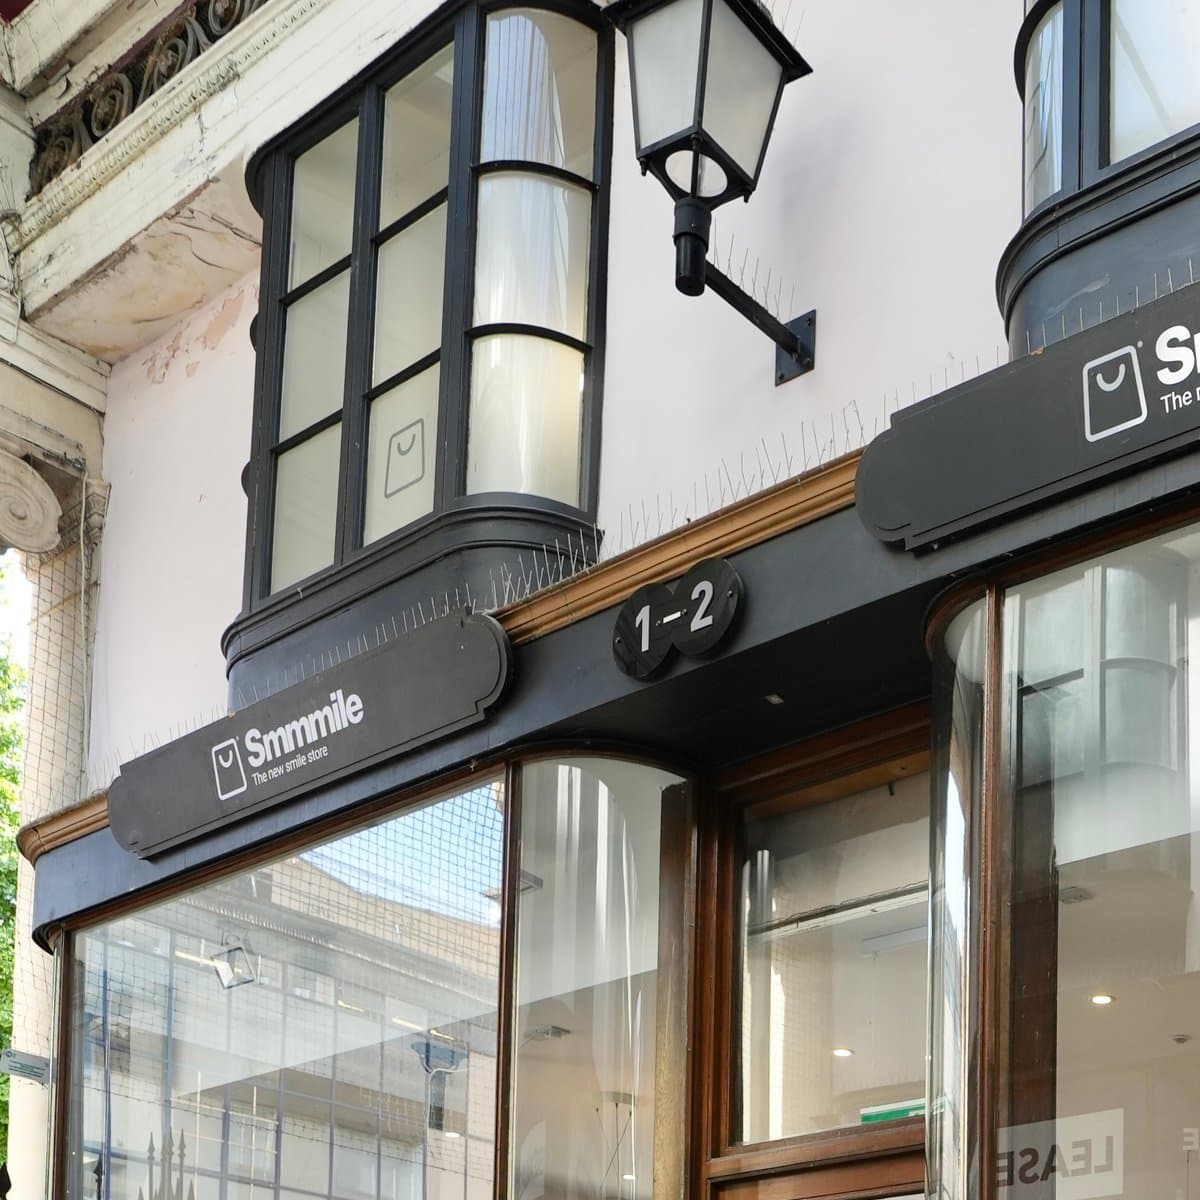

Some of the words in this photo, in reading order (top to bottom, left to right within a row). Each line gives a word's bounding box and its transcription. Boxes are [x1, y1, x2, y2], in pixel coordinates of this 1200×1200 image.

[1160, 390, 1192, 414] The
[244, 688, 364, 768] Smmmile
[251, 771, 268, 787] The
[269, 764, 285, 781] new
[285, 753, 308, 772] smile
[307, 745, 329, 763] store
